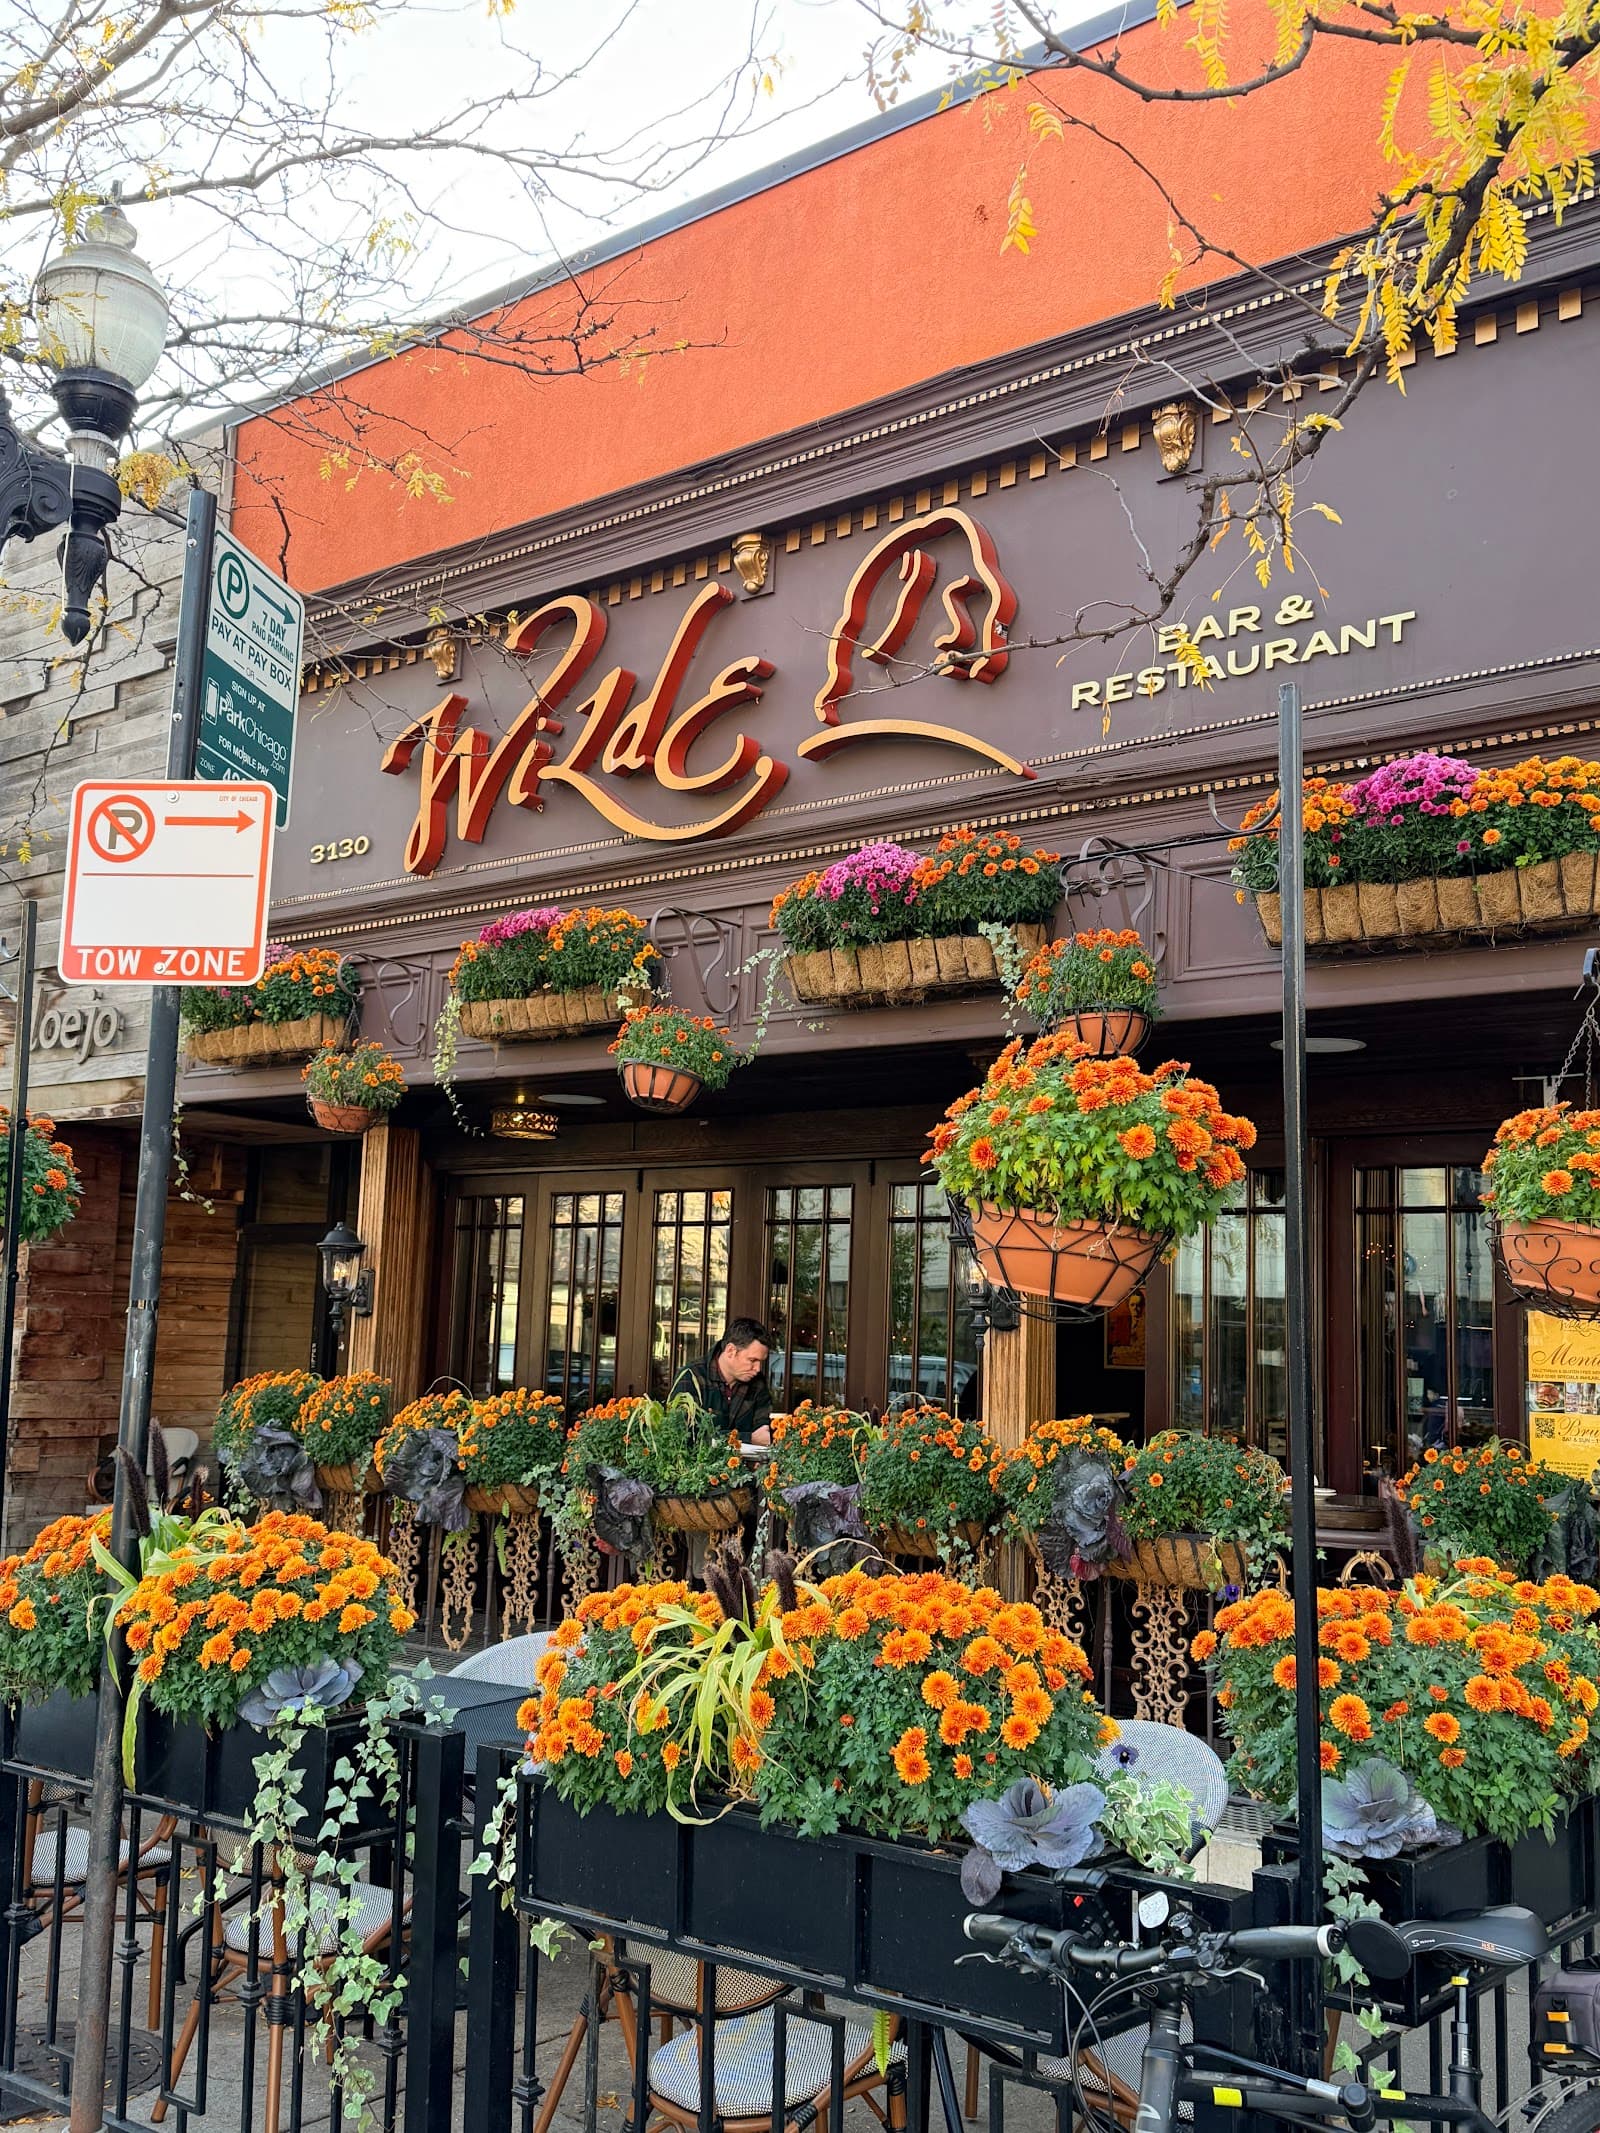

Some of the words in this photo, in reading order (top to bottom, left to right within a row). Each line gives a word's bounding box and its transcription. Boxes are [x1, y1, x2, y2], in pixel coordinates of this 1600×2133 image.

[251, 620, 266, 641] PAID
[267, 634, 295, 664] PARKING
[262, 610, 268, 626] 7
[269, 618, 287, 642] DAY
[1158, 604, 1262, 653] BAR
[1274, 594, 1315, 626] &
[211, 615, 232, 640] PAY
[232, 634, 246, 655] AT
[248, 645, 268, 671] PAY
[269, 663, 292, 692] BOX
[1071, 610, 1417, 709] RESTAURANT
[246, 666, 255, 681] OR
[231, 680, 247, 700] SIGN
[246, 692, 257, 706] UP
[257, 700, 266, 713] AT
[219, 694, 287, 761] ParkChicago
[200, 757, 216, 774] ZONE
[218, 734, 232, 752] FOR
[232, 744, 257, 769] MOBILE
[257, 761, 270, 777] PAY
[310, 835, 369, 864] 3130
[77, 948, 141, 976] TOW
[155, 949, 245, 977] ZONE
